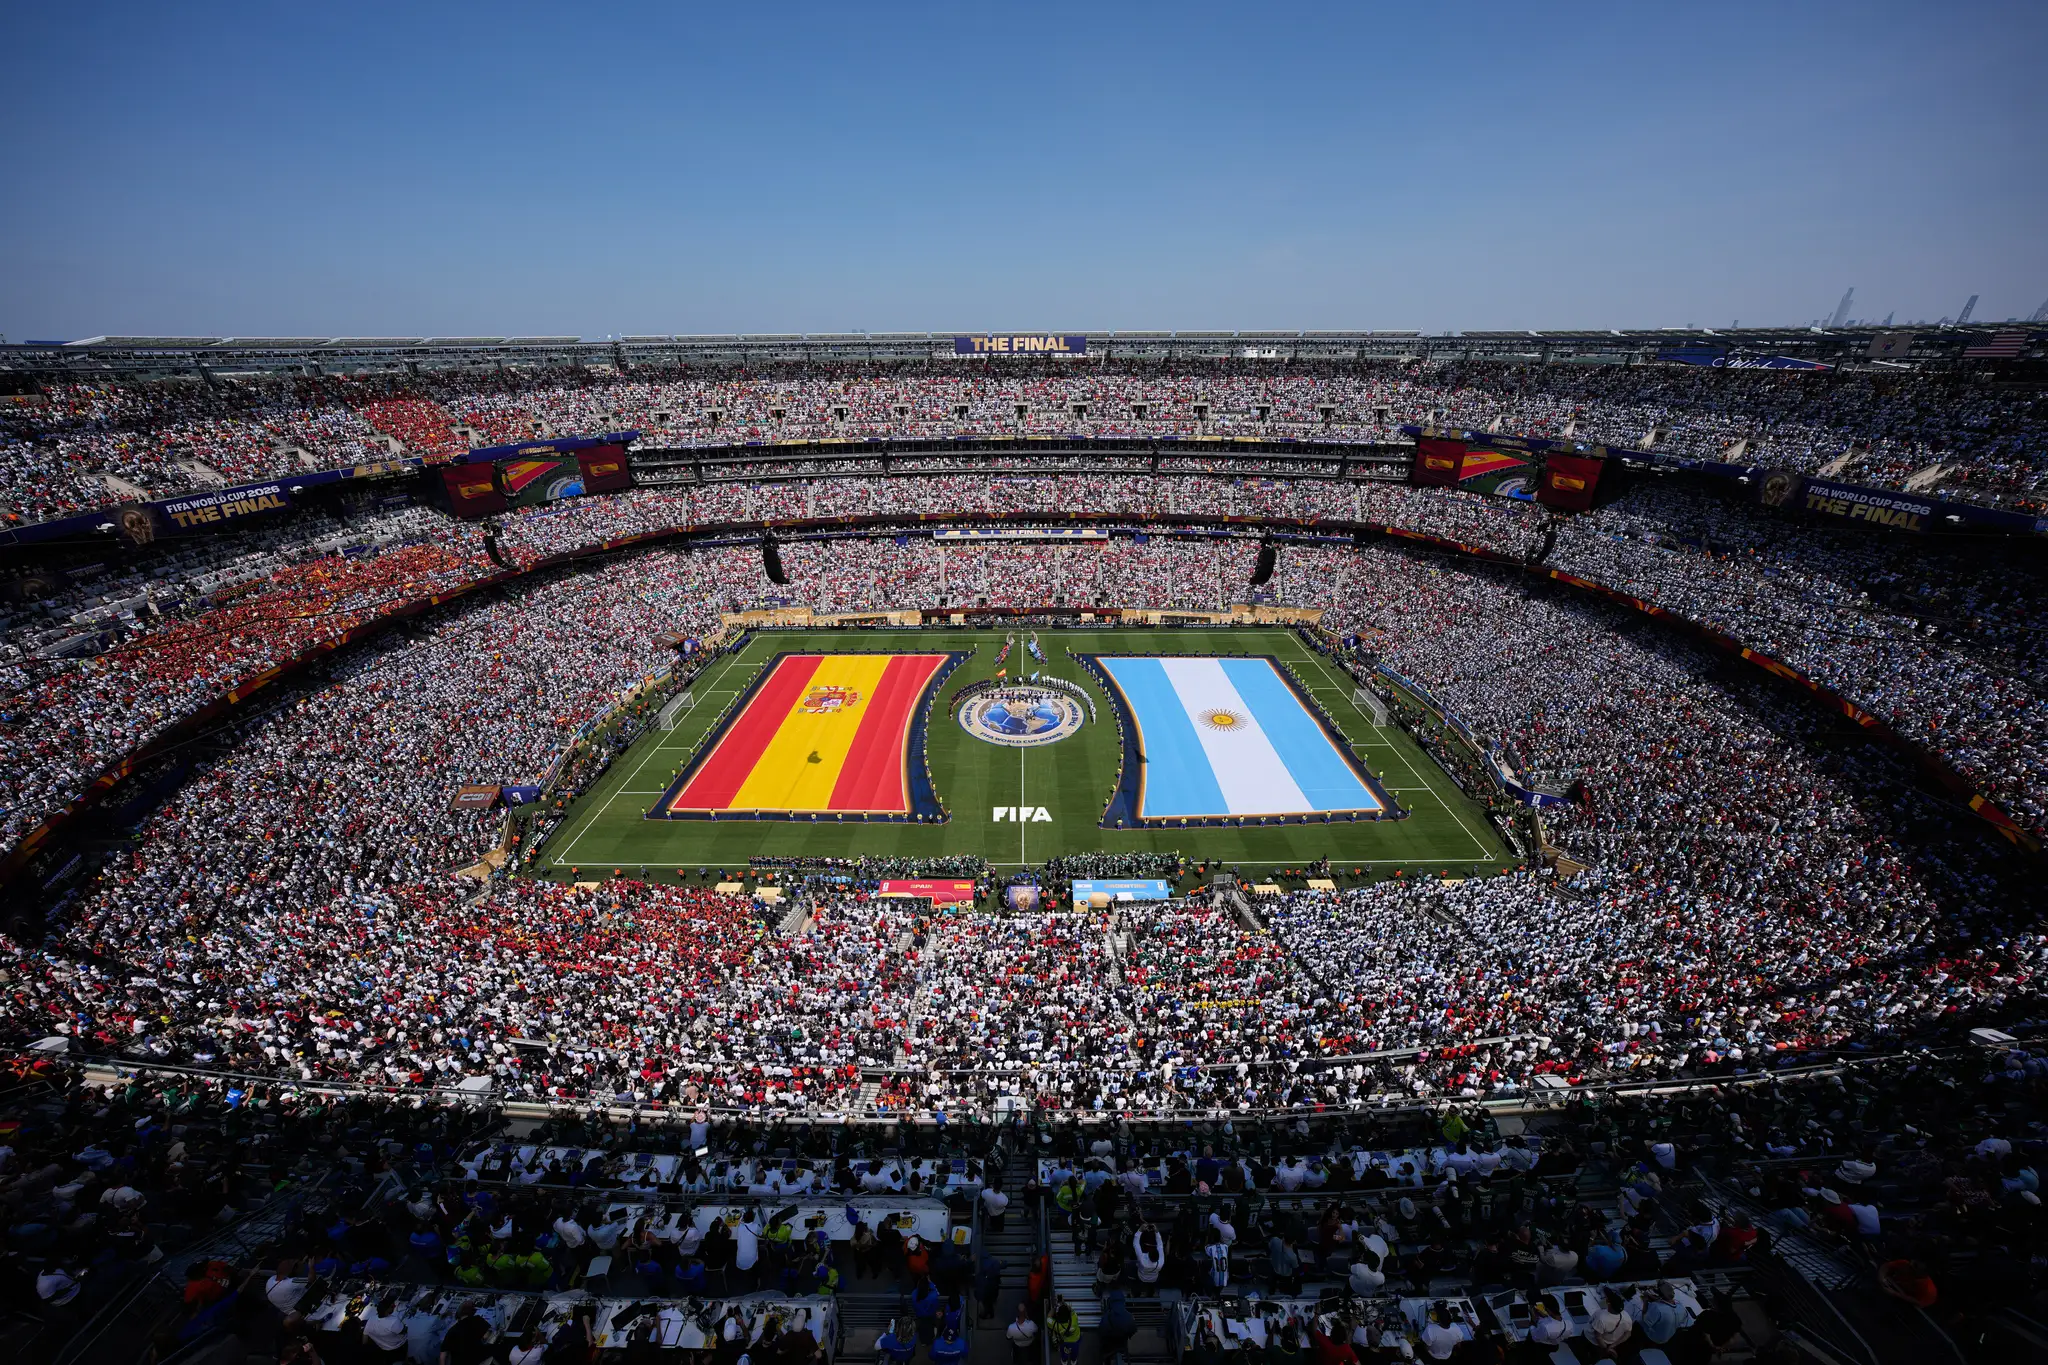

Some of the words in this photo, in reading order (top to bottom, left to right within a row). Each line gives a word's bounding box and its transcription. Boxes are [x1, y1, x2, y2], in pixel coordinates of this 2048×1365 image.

[970, 337, 1009, 351] THE
[1012, 337, 1070, 351] FINAL
[166, 502, 190, 514] FIFA
[192, 496, 227, 509] WORLD
[227, 492, 246, 502] CUP
[247, 485, 280, 498] 2026
[1808, 485, 1829, 498] FIFA
[1830, 489, 1868, 505] WORLD
[1868, 496, 1891, 508] CUP
[1892, 500, 1932, 515] 2026
[170, 507, 220, 528] THE
[222, 494, 287, 519] FINAL
[1806, 494, 1847, 516] THE
[1850, 502, 1921, 531] FINAL
[1039, 732, 1063, 742] 2026
[992, 807, 1052, 822] FIFA
[1214, 1256, 1227, 1272] 10
